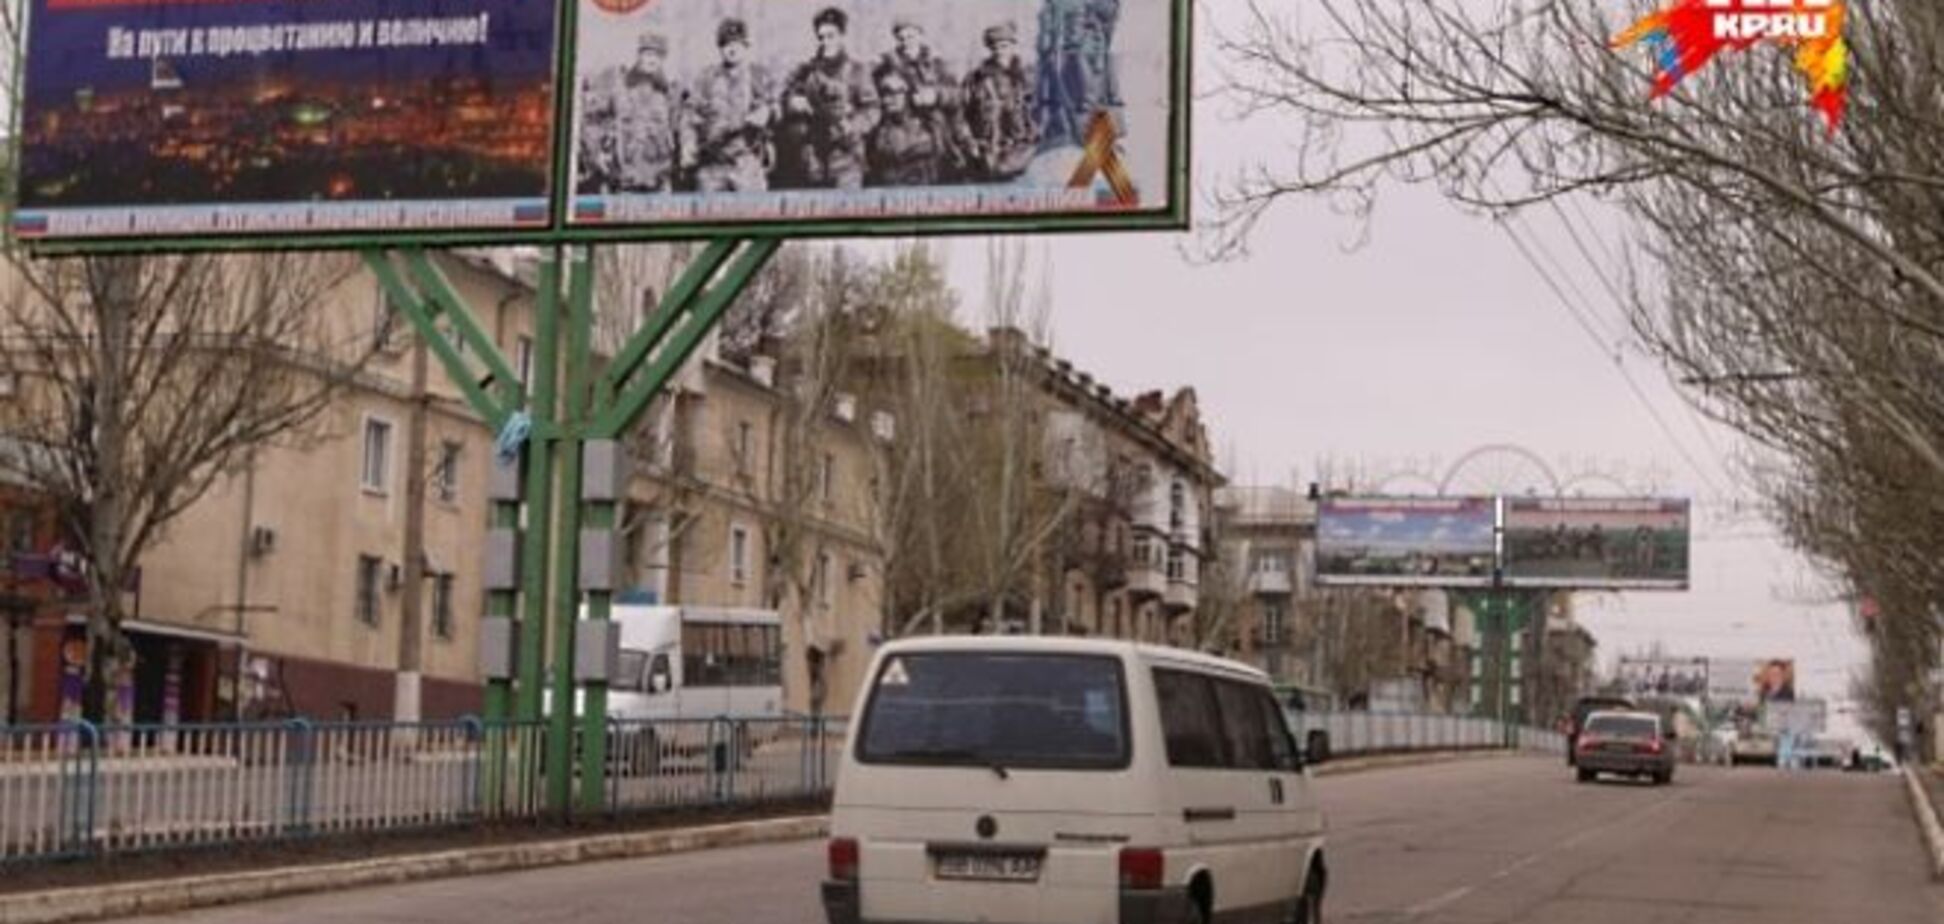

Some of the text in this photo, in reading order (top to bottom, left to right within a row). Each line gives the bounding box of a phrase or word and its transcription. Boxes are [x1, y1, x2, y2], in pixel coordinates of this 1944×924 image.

[107, 26, 135, 58] На
[138, 28, 188, 57] пути
[207, 22, 356, 57] процветанию
[358, 20, 375, 47] и
